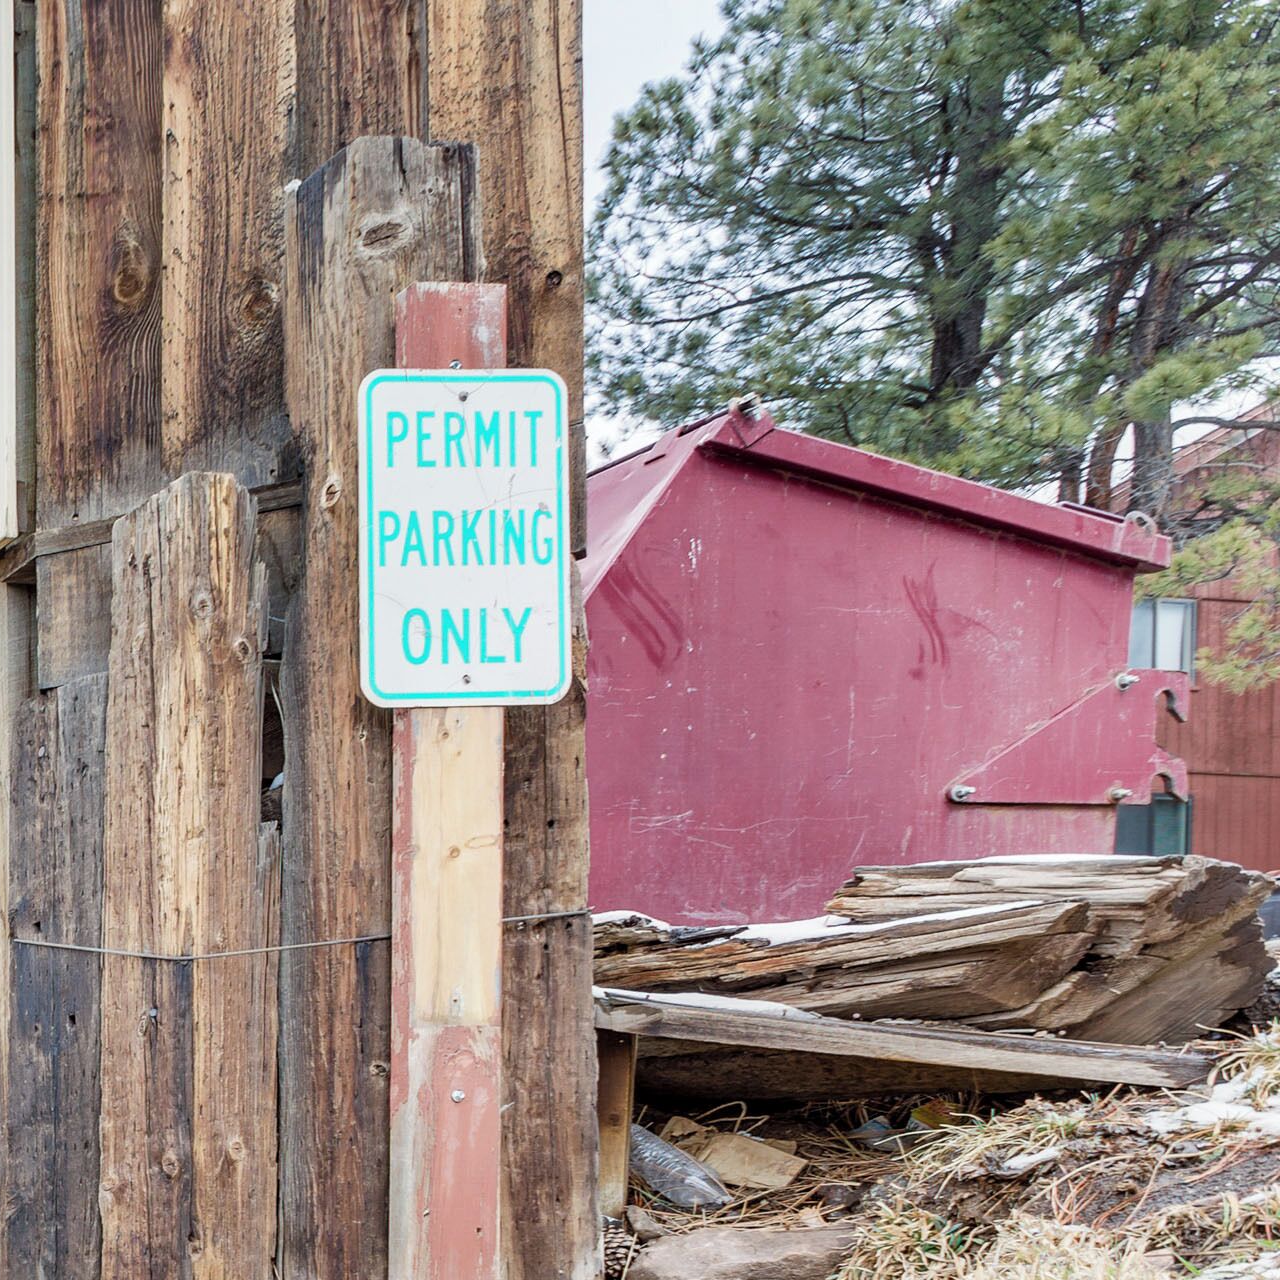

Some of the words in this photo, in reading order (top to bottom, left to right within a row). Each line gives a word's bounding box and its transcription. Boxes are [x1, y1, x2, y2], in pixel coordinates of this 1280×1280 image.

[386, 410, 544, 468] PERMIT
[378, 509, 555, 568] PARKING
[401, 606, 533, 666] ONLY
